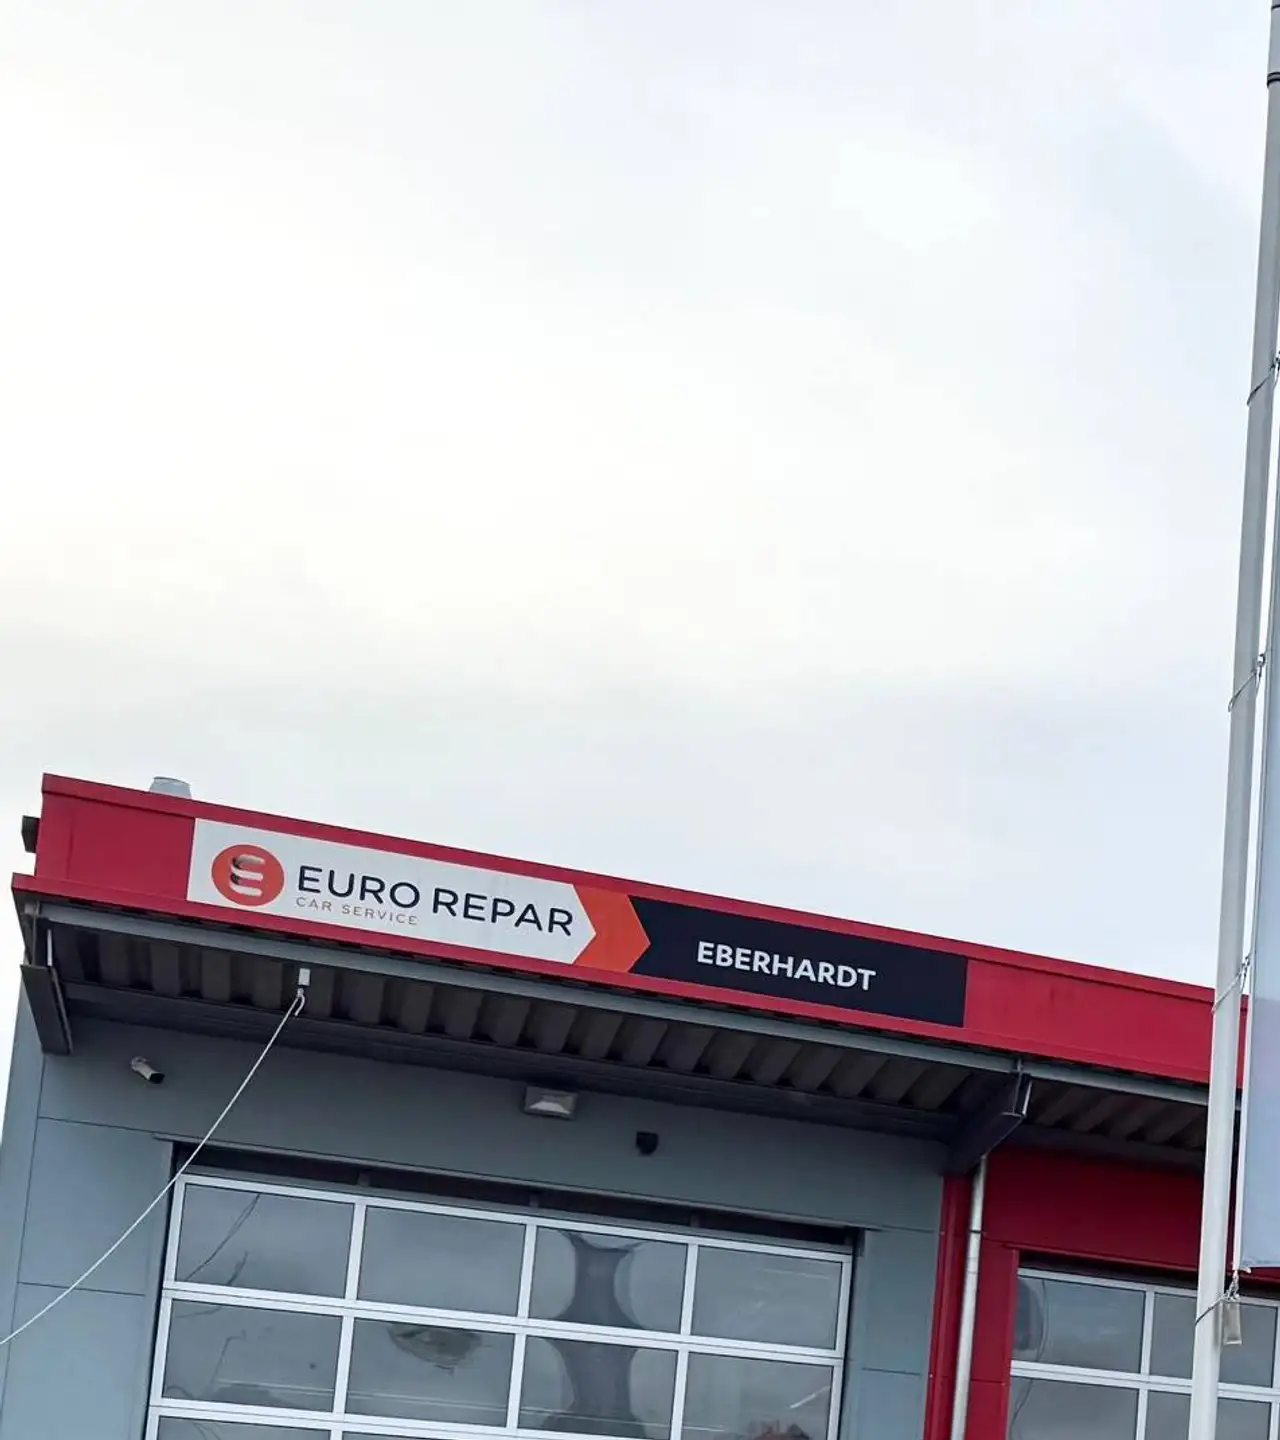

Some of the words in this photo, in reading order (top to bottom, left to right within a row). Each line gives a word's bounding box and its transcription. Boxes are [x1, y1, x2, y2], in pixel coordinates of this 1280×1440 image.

[296, 897, 333, 912] CAR
[342, 904, 419, 925] SERVICE
[298, 865, 421, 909] EURO
[432, 887, 574, 937] REPAR
[696, 940, 877, 991] EBERHARDT
